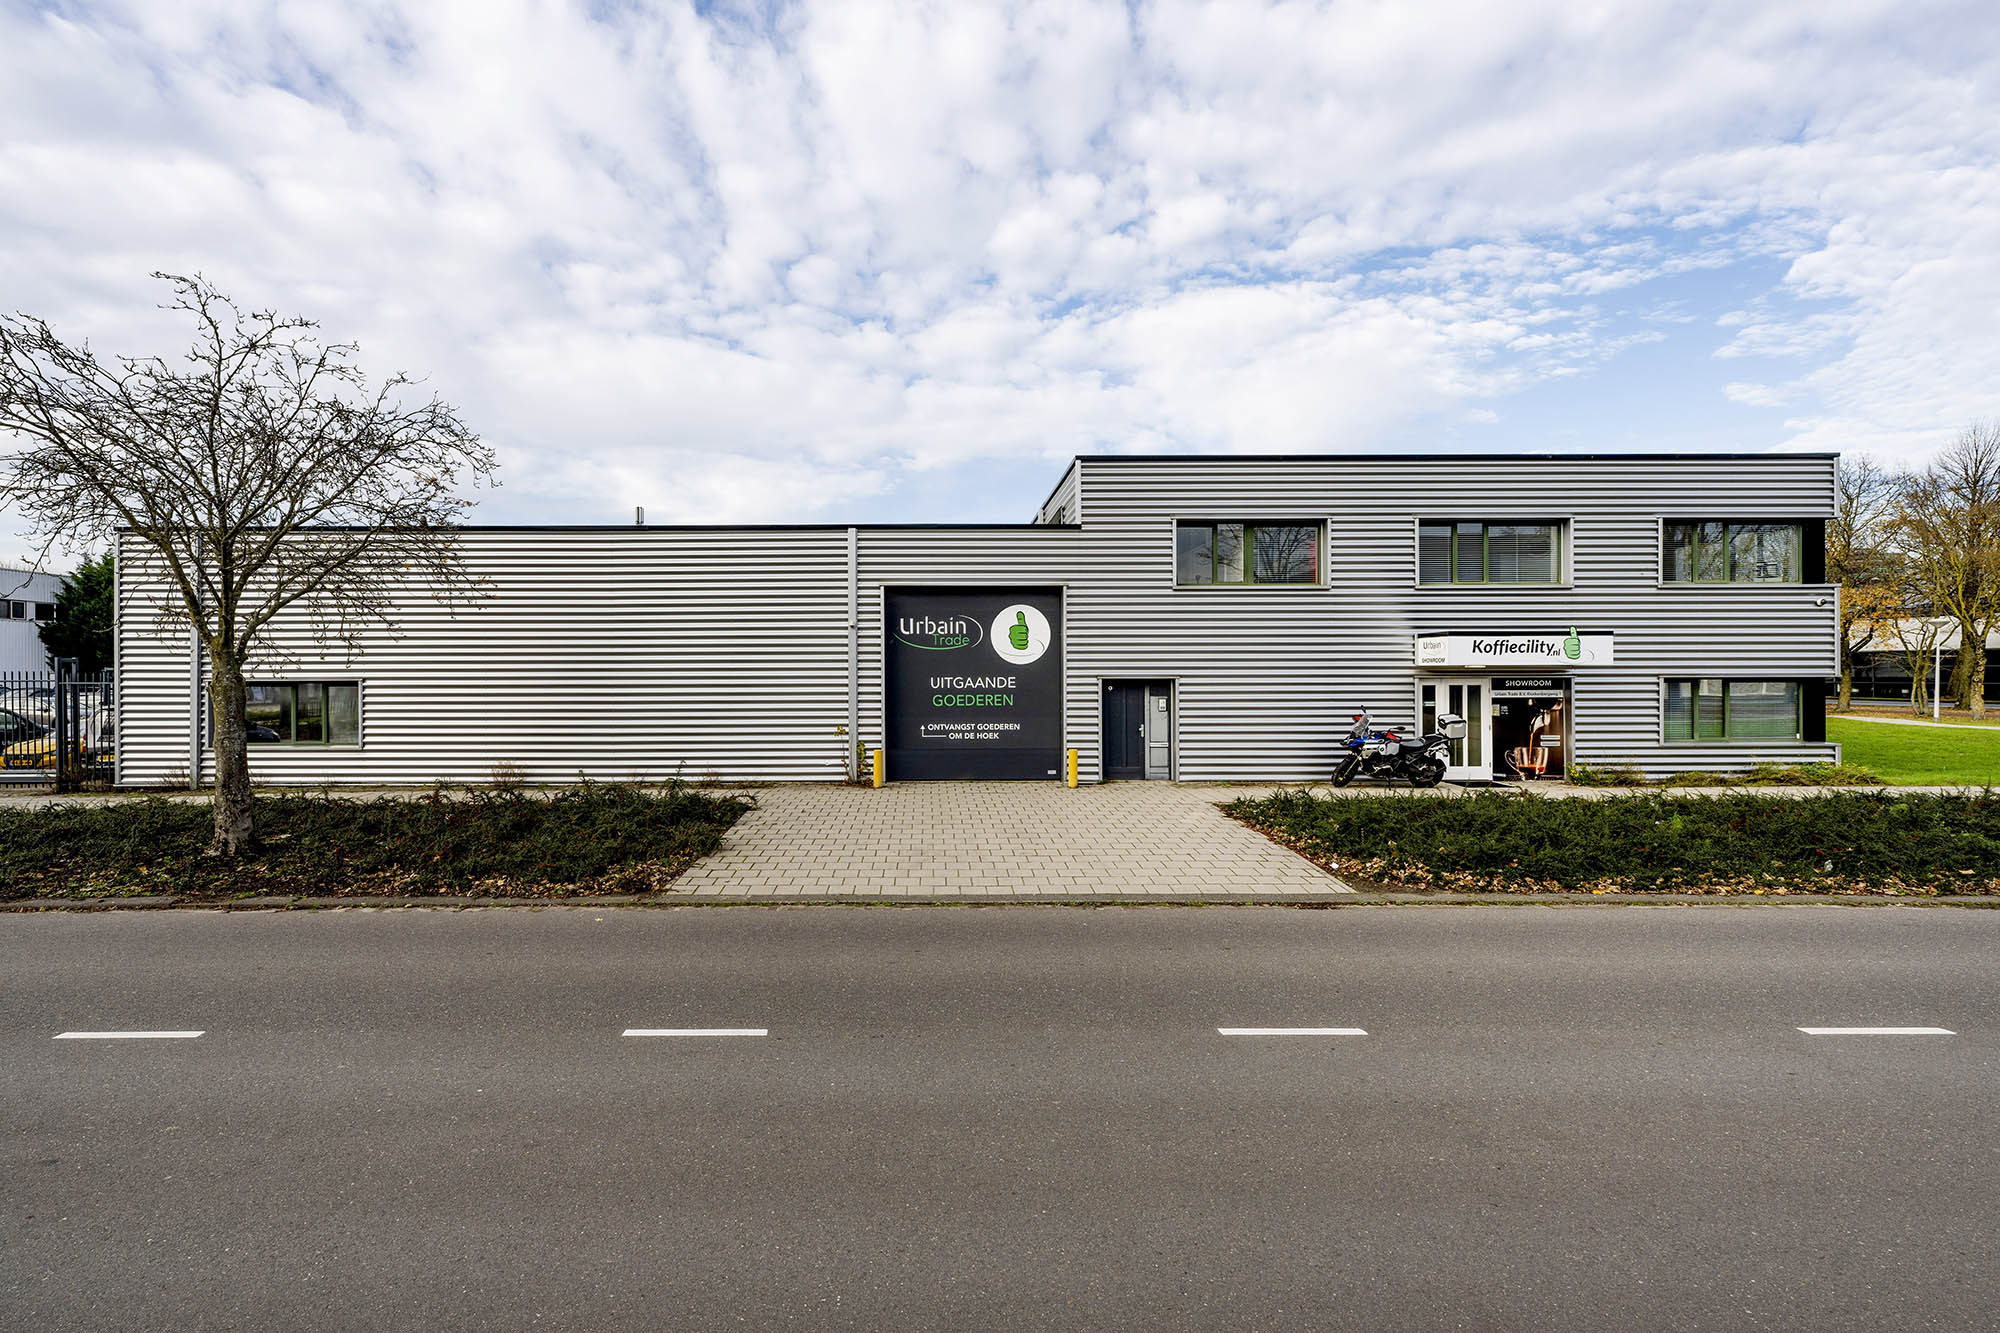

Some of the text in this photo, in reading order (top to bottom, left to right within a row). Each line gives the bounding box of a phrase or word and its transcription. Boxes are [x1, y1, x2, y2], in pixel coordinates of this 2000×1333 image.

[900, 616, 967, 634] Urbain
[932, 633, 970, 646] Trade
[930, 676, 1016, 689] UITGAANDE
[932, 694, 1014, 707] GOEDEREN
[927, 723, 1021, 731] ONTVANGST GOEDEREN
[948, 732, 1000, 740] OM DE HOEK
